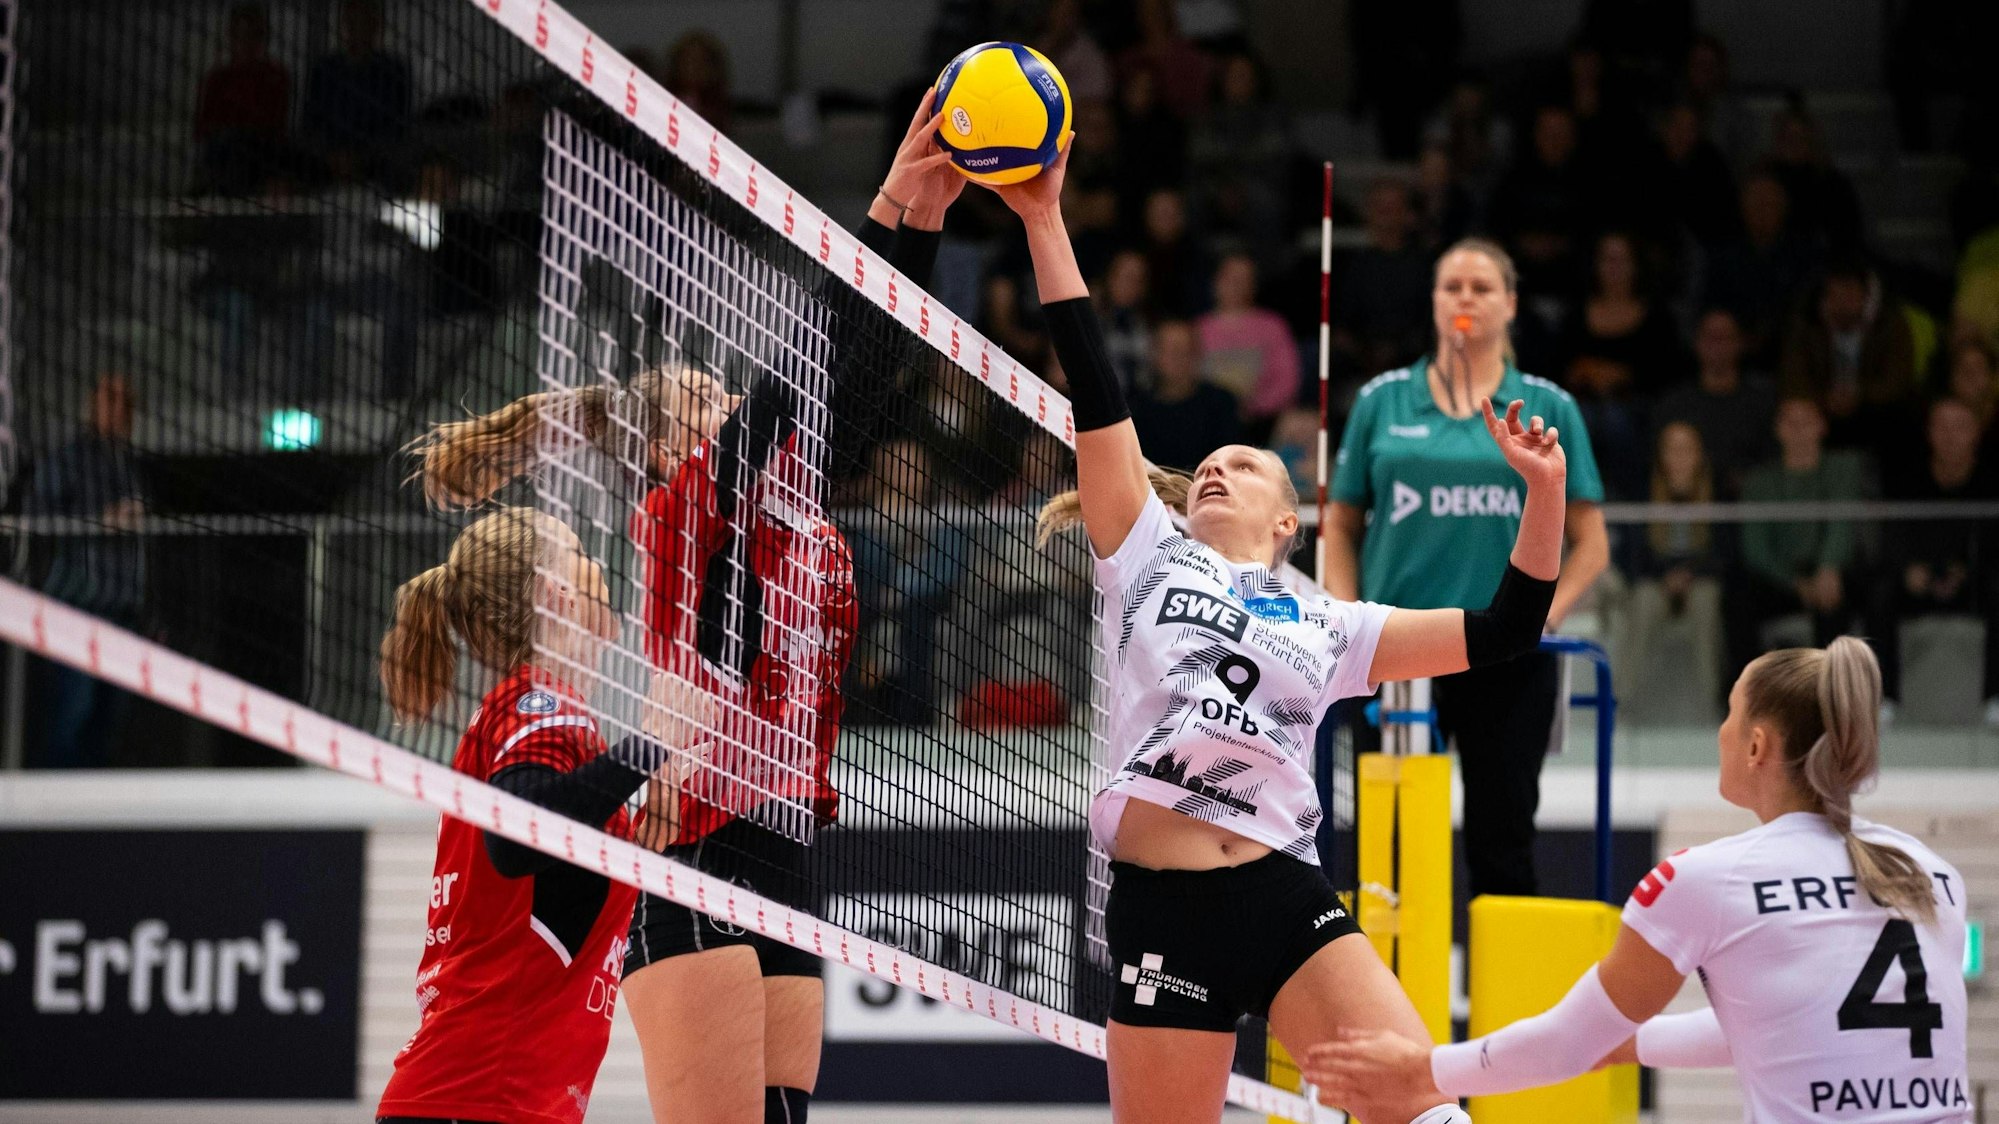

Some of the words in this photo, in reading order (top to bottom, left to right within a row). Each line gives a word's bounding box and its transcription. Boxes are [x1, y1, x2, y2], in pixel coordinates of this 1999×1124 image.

[956, 110, 970, 128] DVV
[964, 156, 999, 167] V200W
[1429, 486, 1521, 519] DEKRA
[1165, 593, 1241, 632] SWE
[1251, 633, 1293, 667] Erfurt
[1293, 659, 1323, 693] Gruppe
[1256, 622, 1322, 673] Stadtwerke
[1215, 653, 1261, 706] 9
[1201, 697, 1259, 736] OFB
[1193, 720, 1287, 766] Projektentwicklung
[1752, 871, 1956, 915] ERFT
[1312, 907, 1346, 930] JAKO
[33, 917, 326, 1016] Erfurt.
[1138, 976, 1208, 1003] RECYCLING
[1837, 917, 1944, 1059] 4
[1809, 1077, 1968, 1114] PAVLOVA
